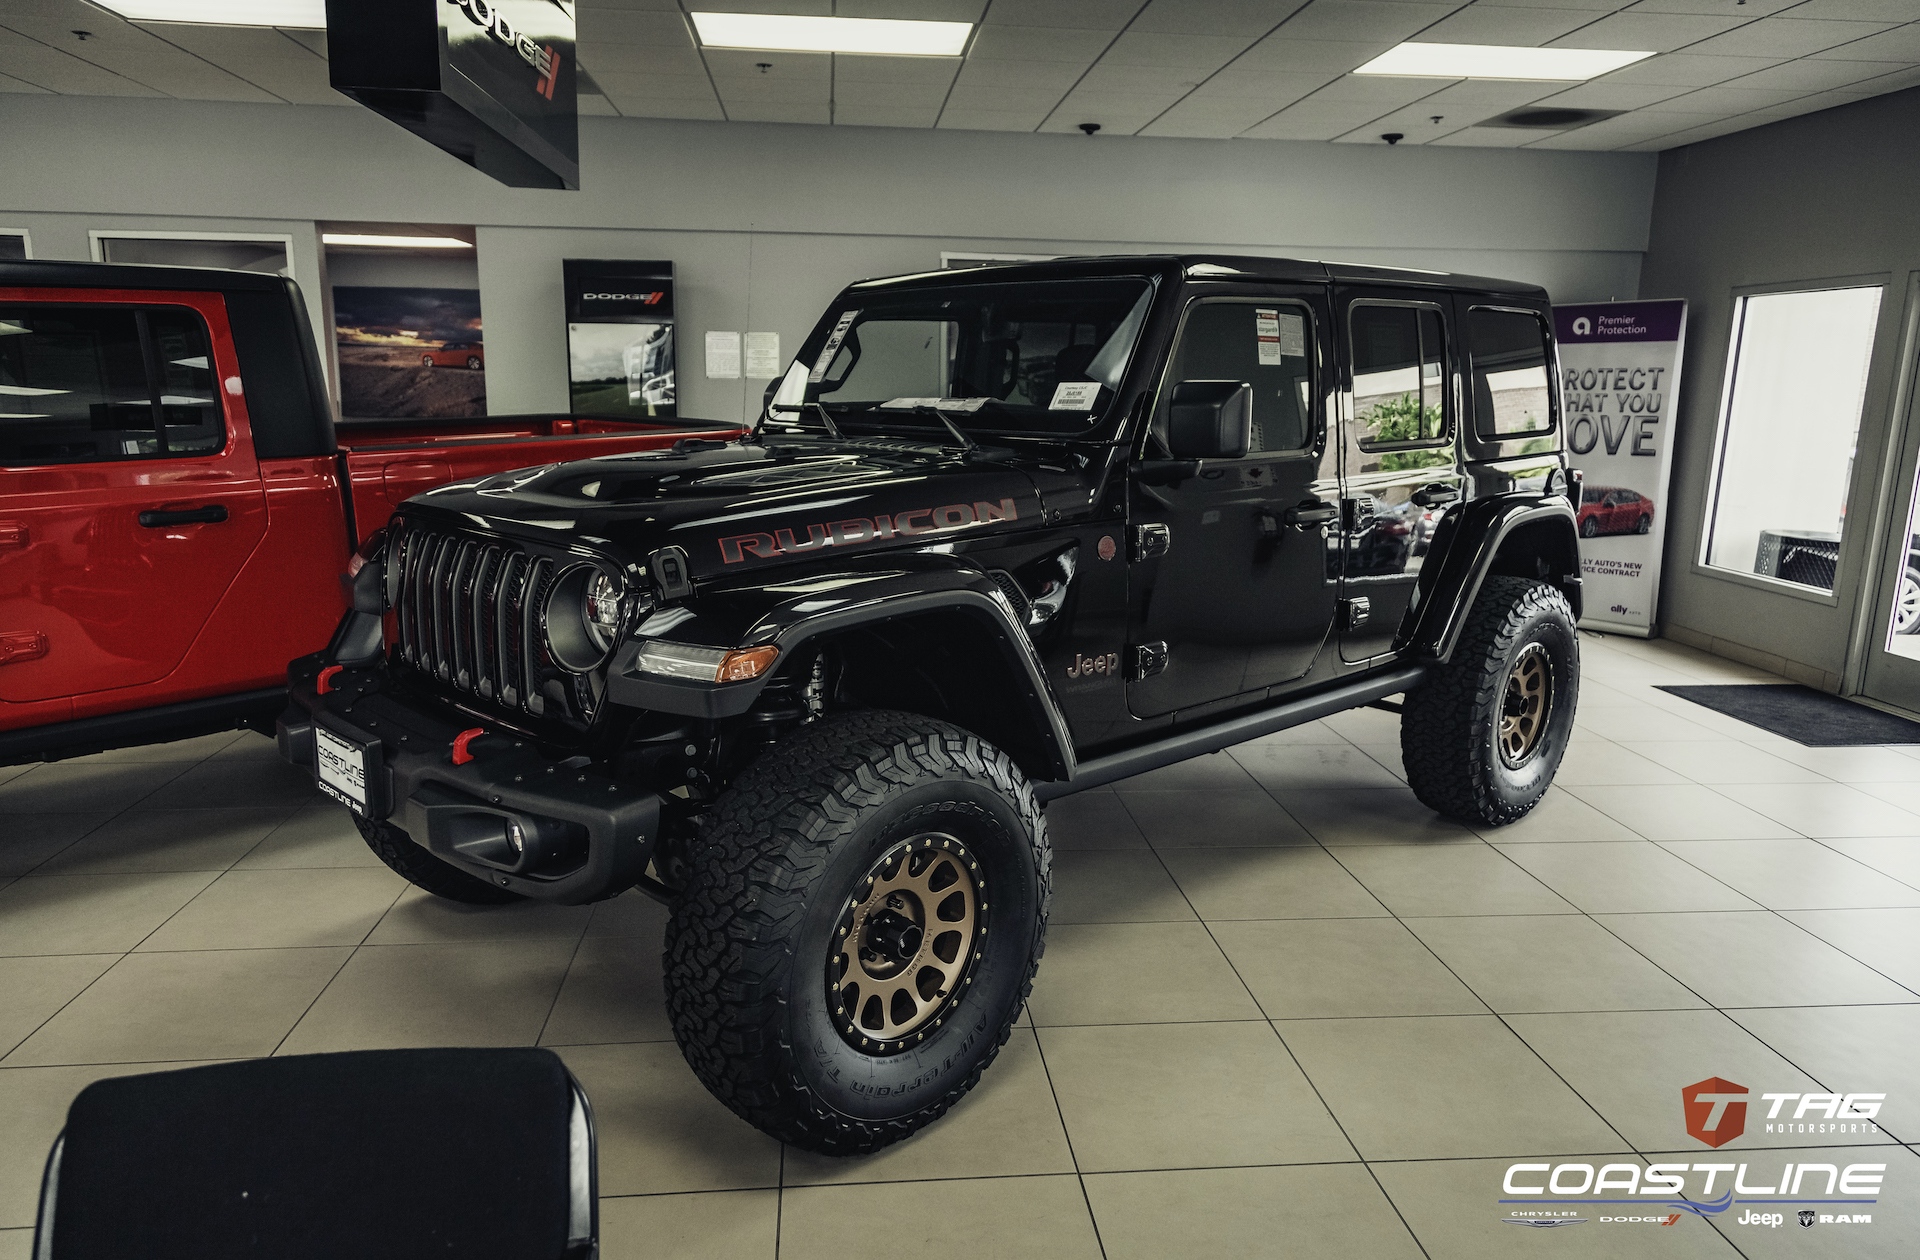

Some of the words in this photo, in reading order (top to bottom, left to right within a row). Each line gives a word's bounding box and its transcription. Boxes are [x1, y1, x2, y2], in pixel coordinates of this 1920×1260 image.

[450, 0, 552, 80] ODGE
[583, 292, 652, 300] DODGE
[1597, 325, 1647, 335] Protection
[1598, 315, 1635, 325] Premier
[1562, 367, 1664, 391] ROTECT
[1564, 392, 1608, 413] HAT
[1616, 392, 1662, 413] YOU
[1567, 414, 1659, 456] OVE
[718, 498, 1017, 564] RUBICON
[1595, 559, 1622, 568] AUTO'S
[1624, 562, 1642, 570] NEW
[1598, 567, 1640, 577] CONTRACT
[1611, 604, 1628, 615] ally
[1067, 652, 1119, 679] Jeep
[318, 744, 365, 780] COASTLINE
[318, 780, 351, 807] COASTLINE
